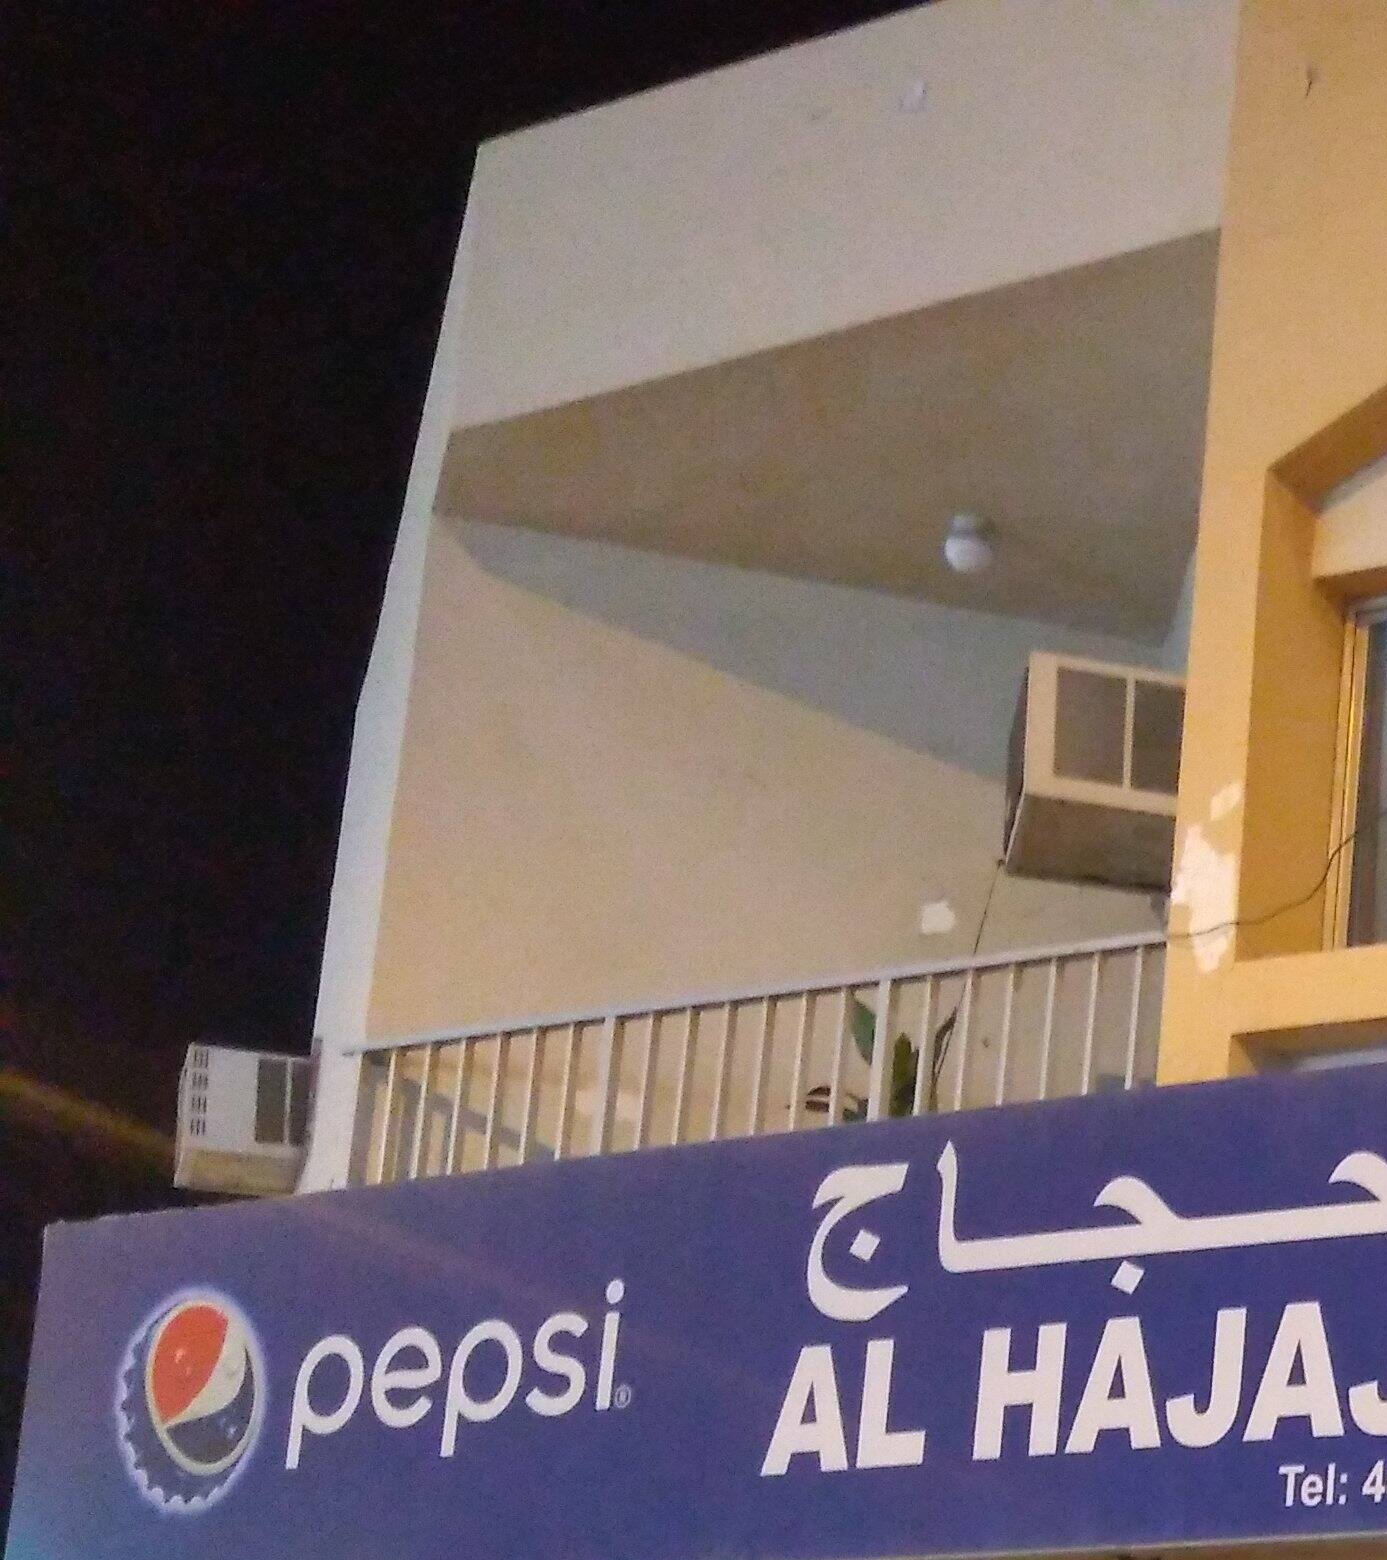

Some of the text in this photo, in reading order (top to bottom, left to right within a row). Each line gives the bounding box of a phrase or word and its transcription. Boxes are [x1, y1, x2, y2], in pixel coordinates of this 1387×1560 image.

[284, 1278, 627, 1470] pepsi
[759, 1337, 927, 1478] AL
[1277, 1462, 1350, 1508] Tel:
